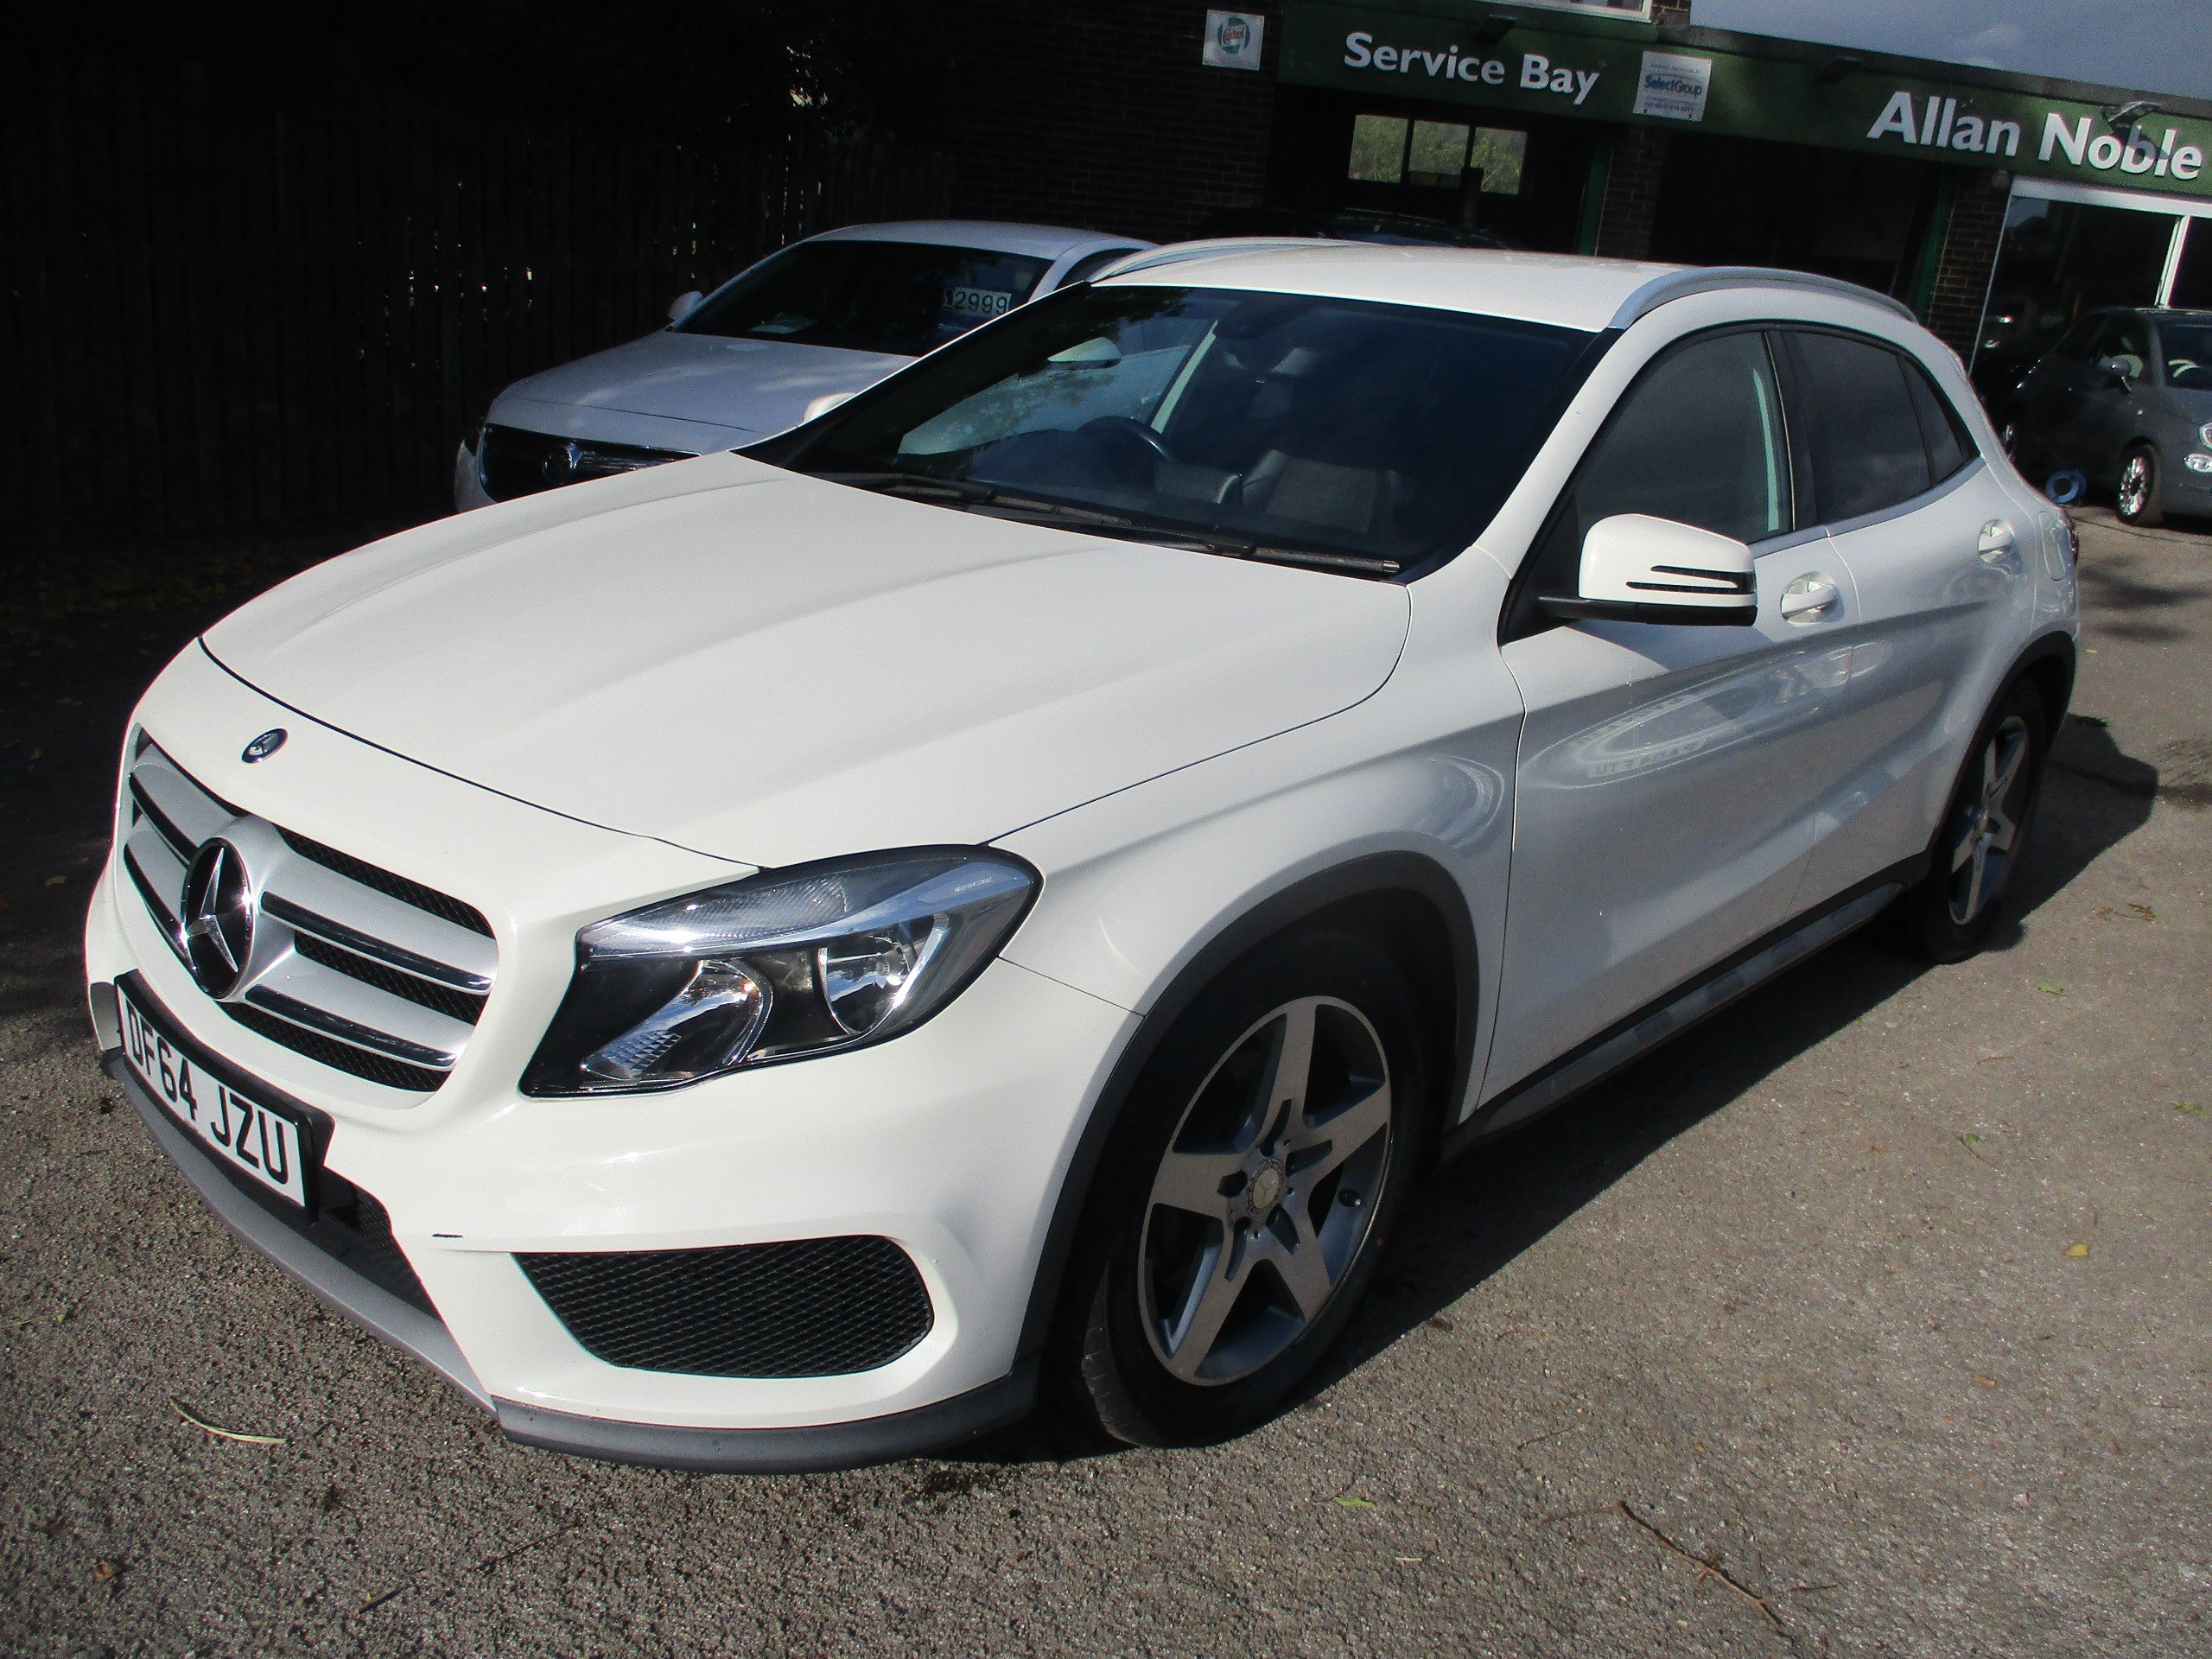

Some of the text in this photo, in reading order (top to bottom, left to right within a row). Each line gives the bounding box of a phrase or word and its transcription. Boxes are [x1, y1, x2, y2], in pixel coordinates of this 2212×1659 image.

[1344, 32, 1599, 105] Service Bay
[1866, 91, 2202, 181] Allan Noble
[126, 999, 289, 1185] DF64 JZU
